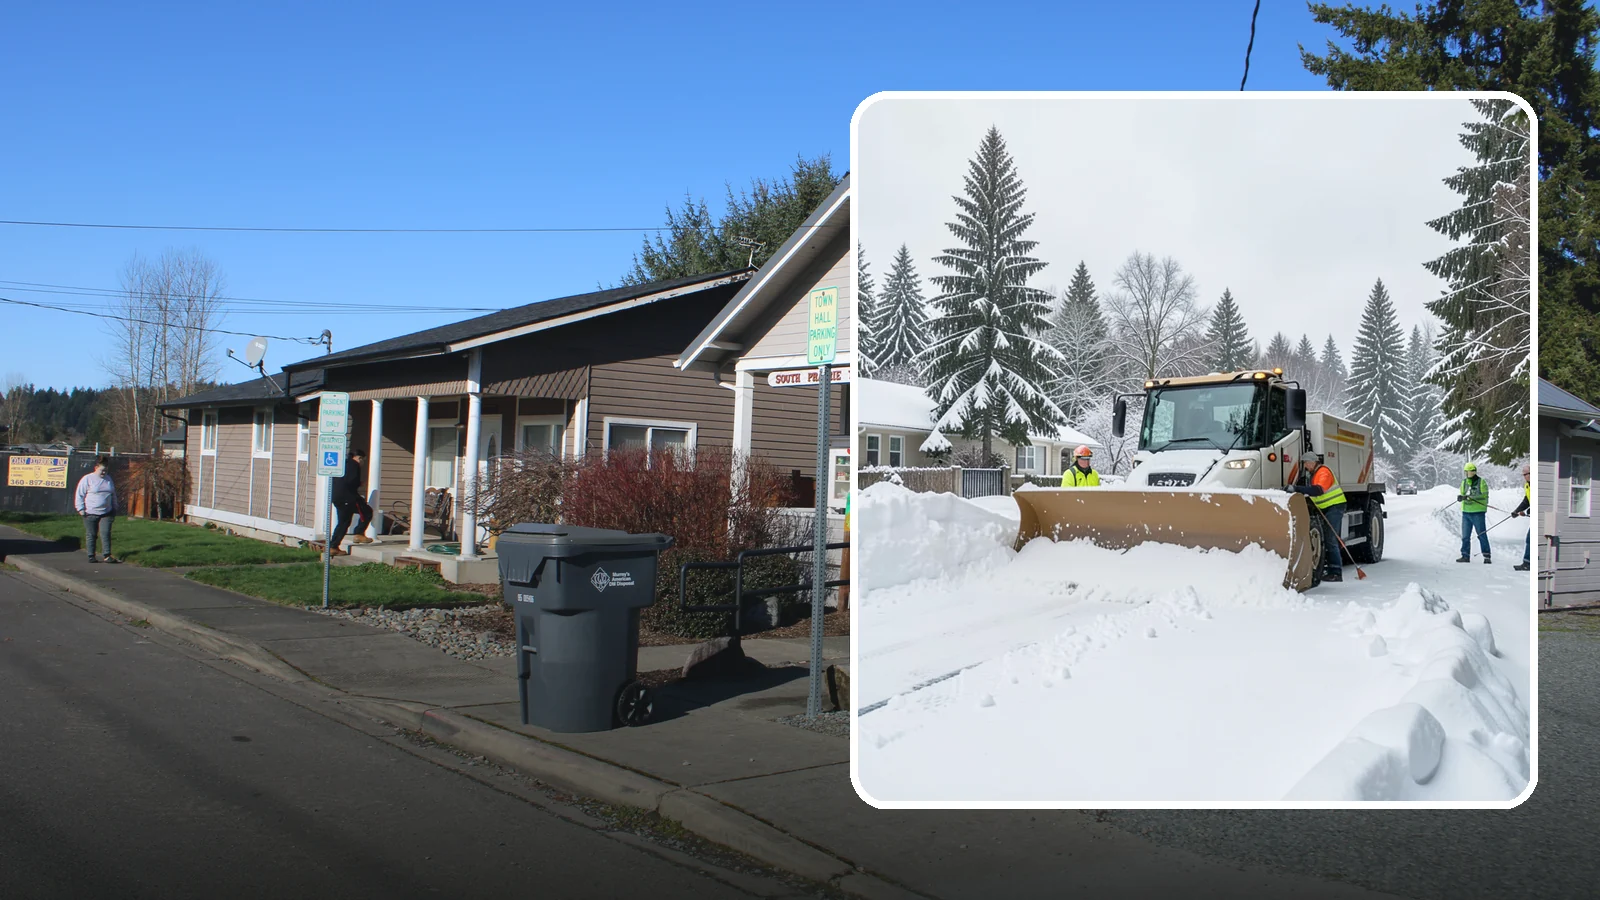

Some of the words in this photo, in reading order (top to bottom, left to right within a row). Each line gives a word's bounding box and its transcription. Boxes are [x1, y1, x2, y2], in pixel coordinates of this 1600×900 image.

[815, 294, 833, 308] TOWN
[815, 312, 831, 324] HALL
[810, 327, 836, 340] PARKING
[813, 344, 831, 357] ONLY
[775, 373, 801, 384] SOUTH
